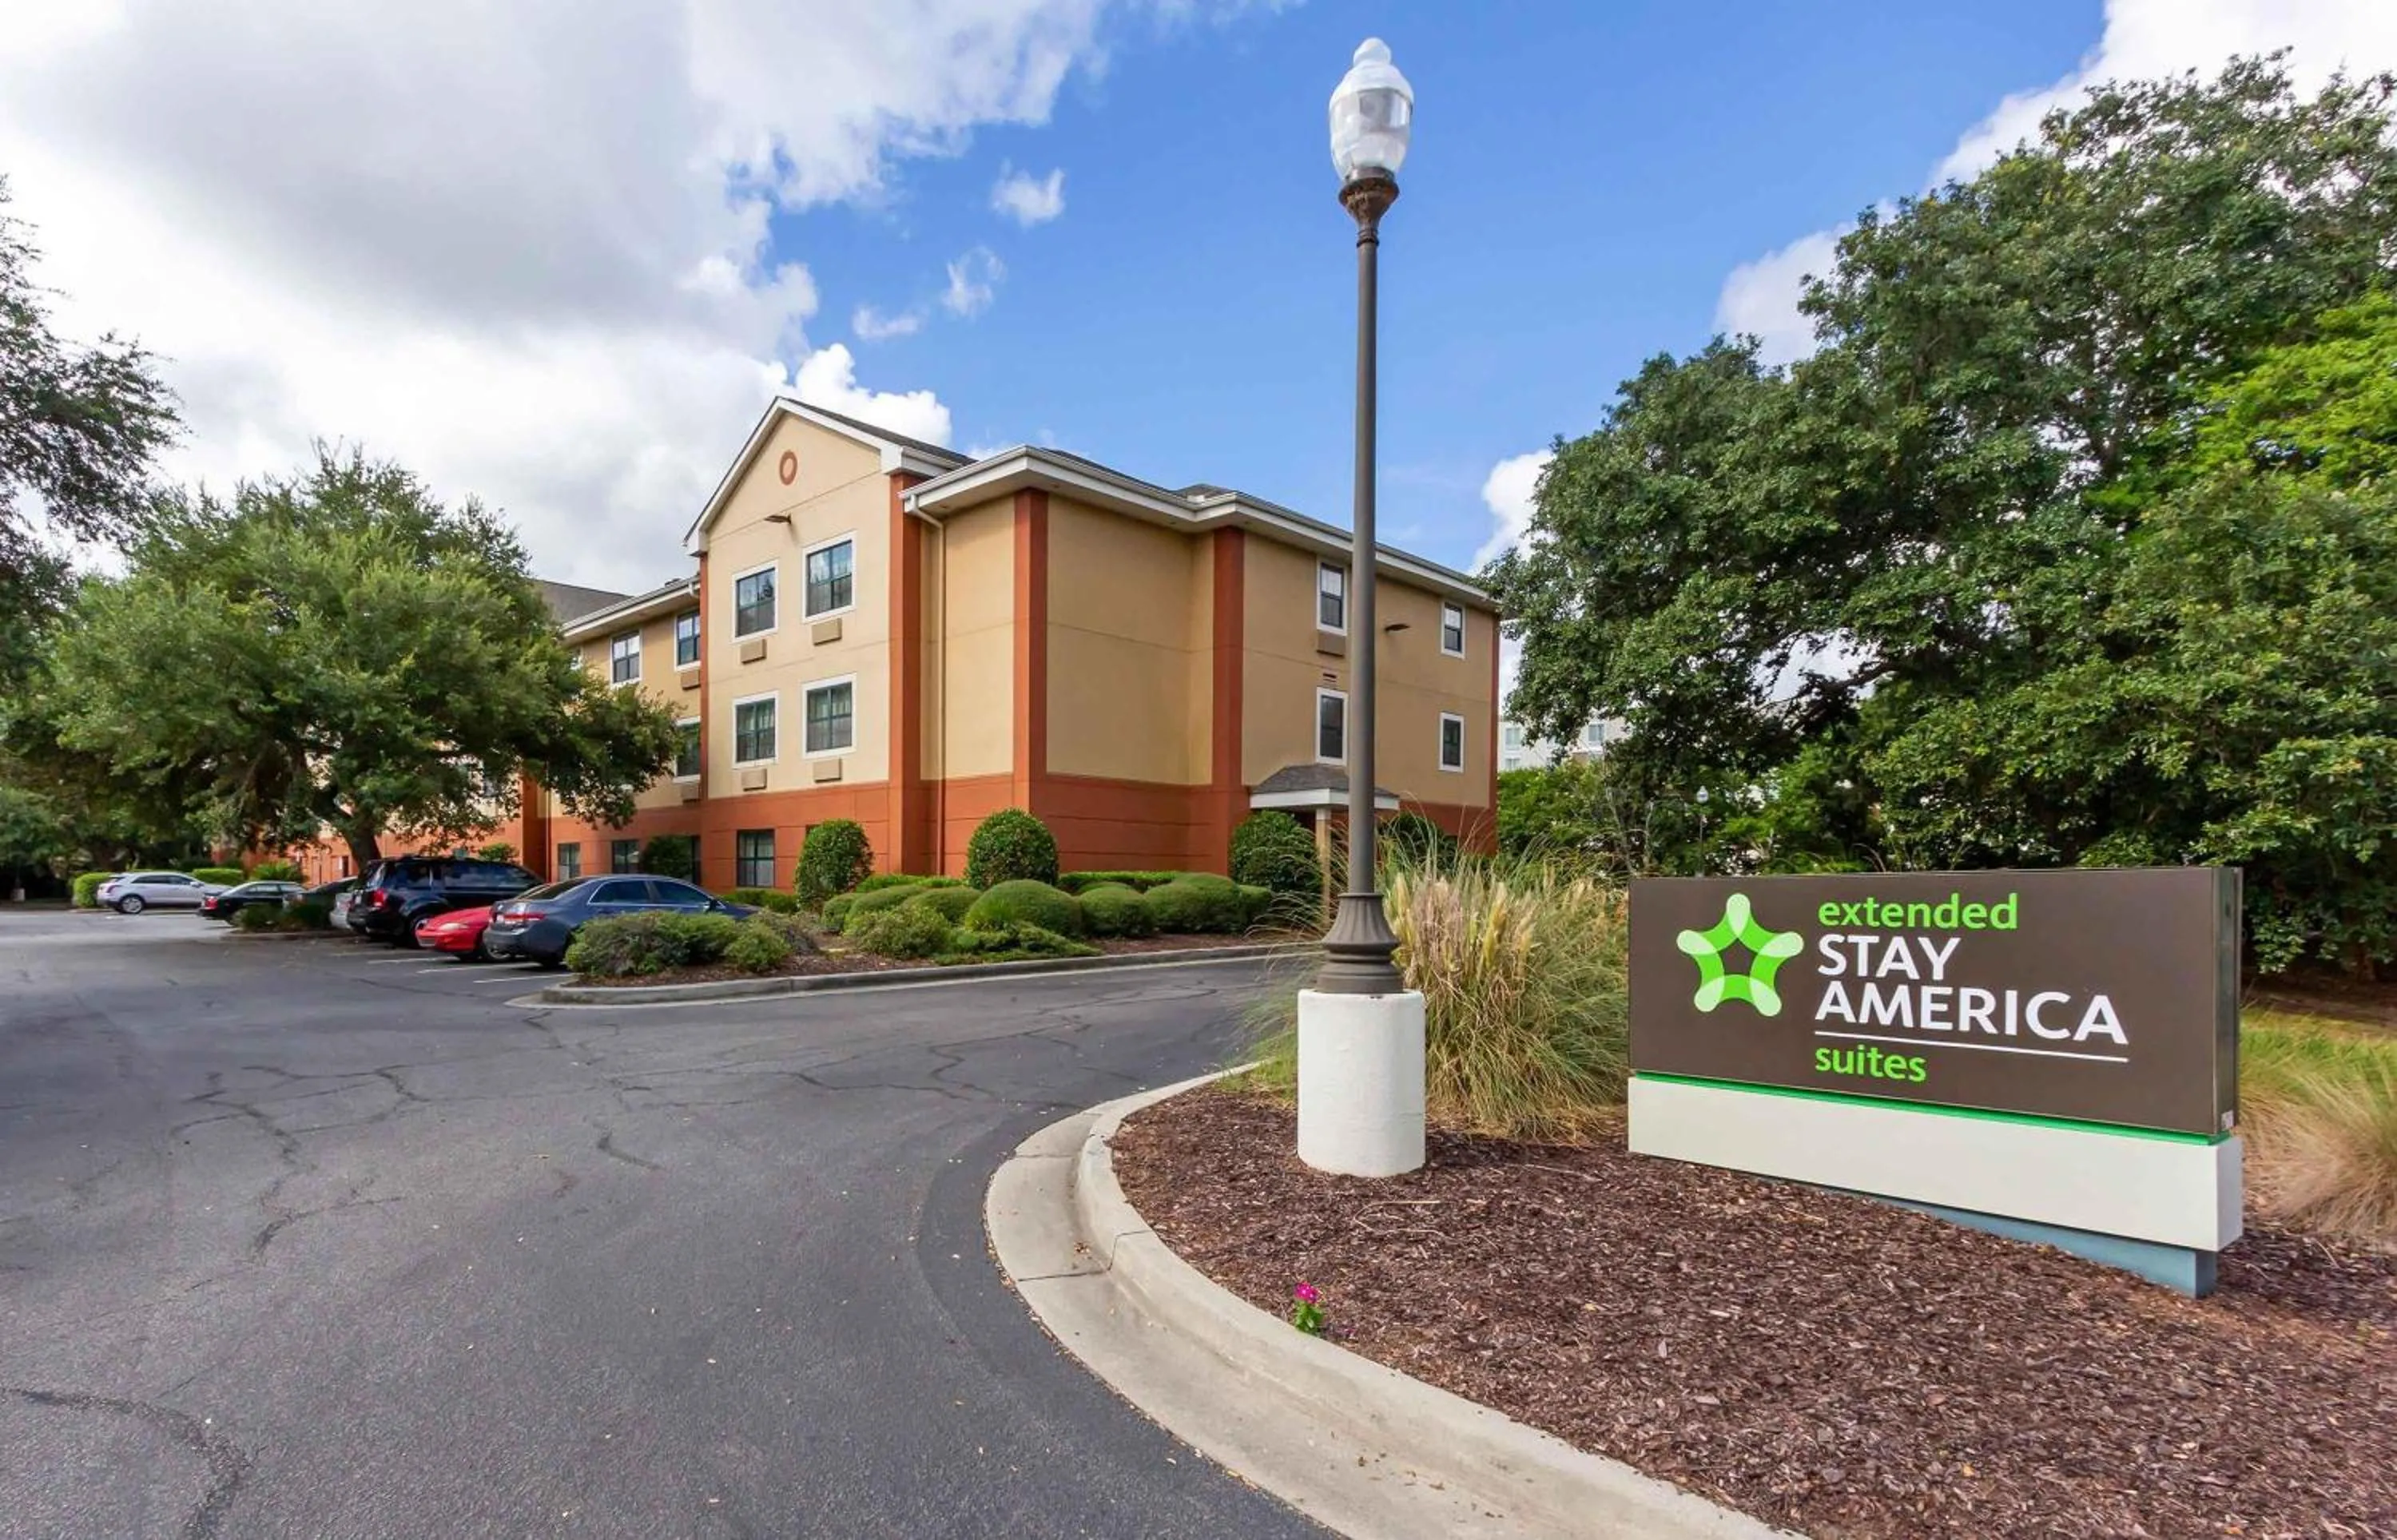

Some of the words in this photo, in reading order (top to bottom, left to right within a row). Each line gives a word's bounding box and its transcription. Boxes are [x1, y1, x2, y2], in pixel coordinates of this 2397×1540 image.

[1818, 893, 2018, 930] extended
[1818, 934, 1961, 981] STAY
[1815, 979, 2129, 1045] AMERICA
[1815, 1044, 1926, 1082] suites
